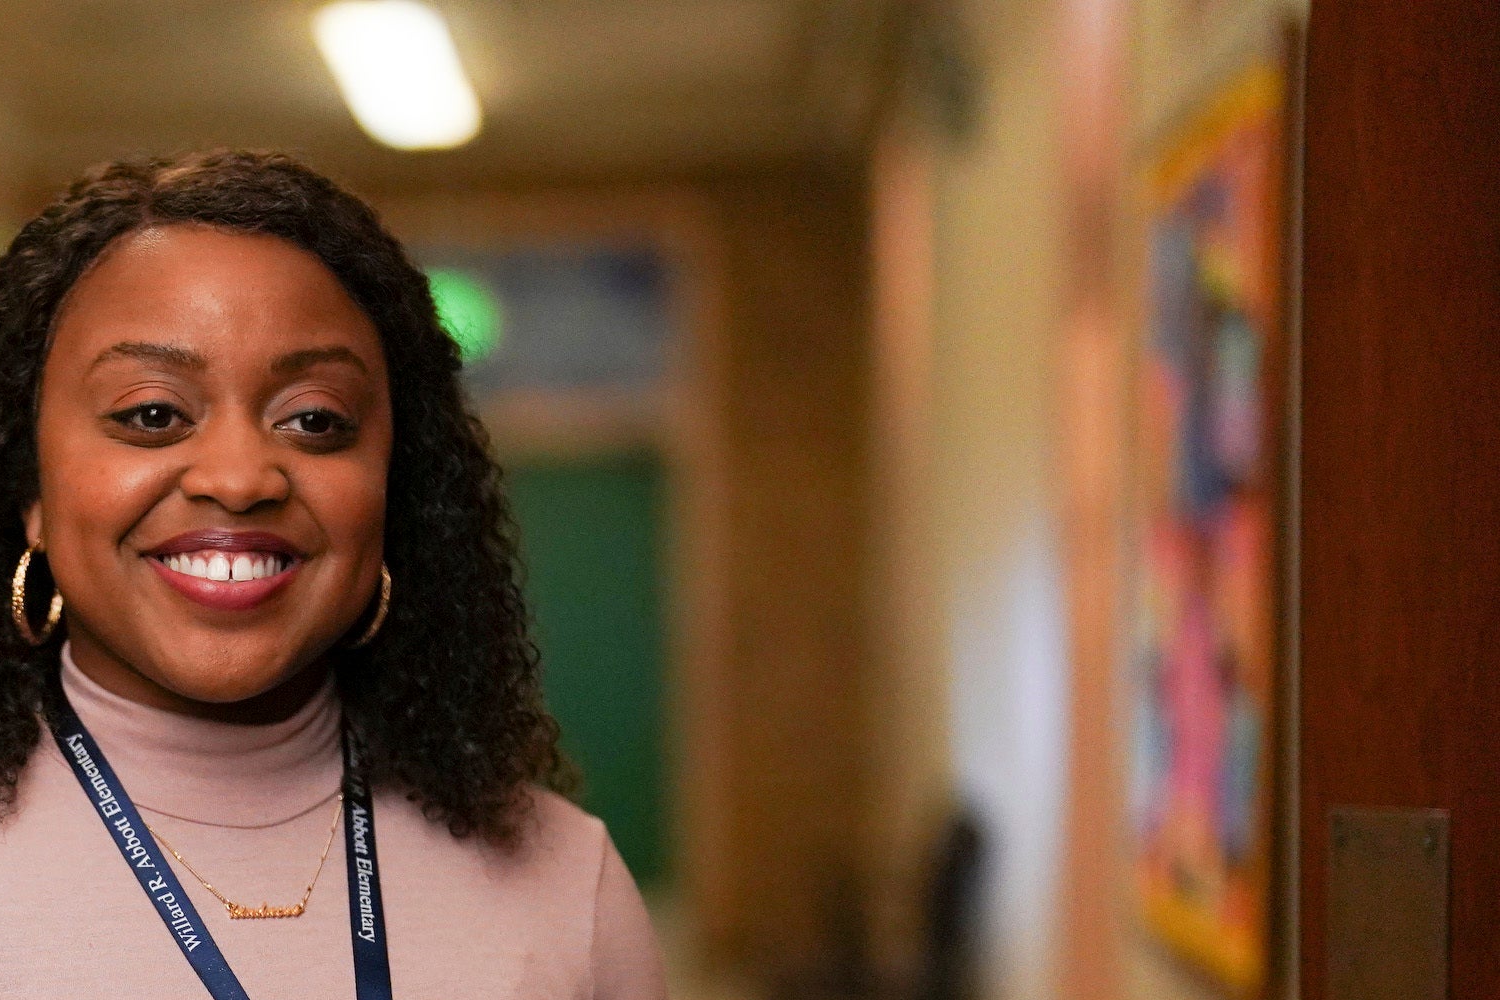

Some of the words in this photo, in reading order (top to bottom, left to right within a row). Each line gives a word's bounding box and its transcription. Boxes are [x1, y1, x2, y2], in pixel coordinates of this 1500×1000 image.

[65, 733, 122, 818] Elementary
[114, 816, 155, 869] Abbott
[352, 800, 368, 855] Abbott
[149, 871, 168, 892] R.
[356, 857, 375, 943] Elementary
[157, 892, 201, 952] Willard
